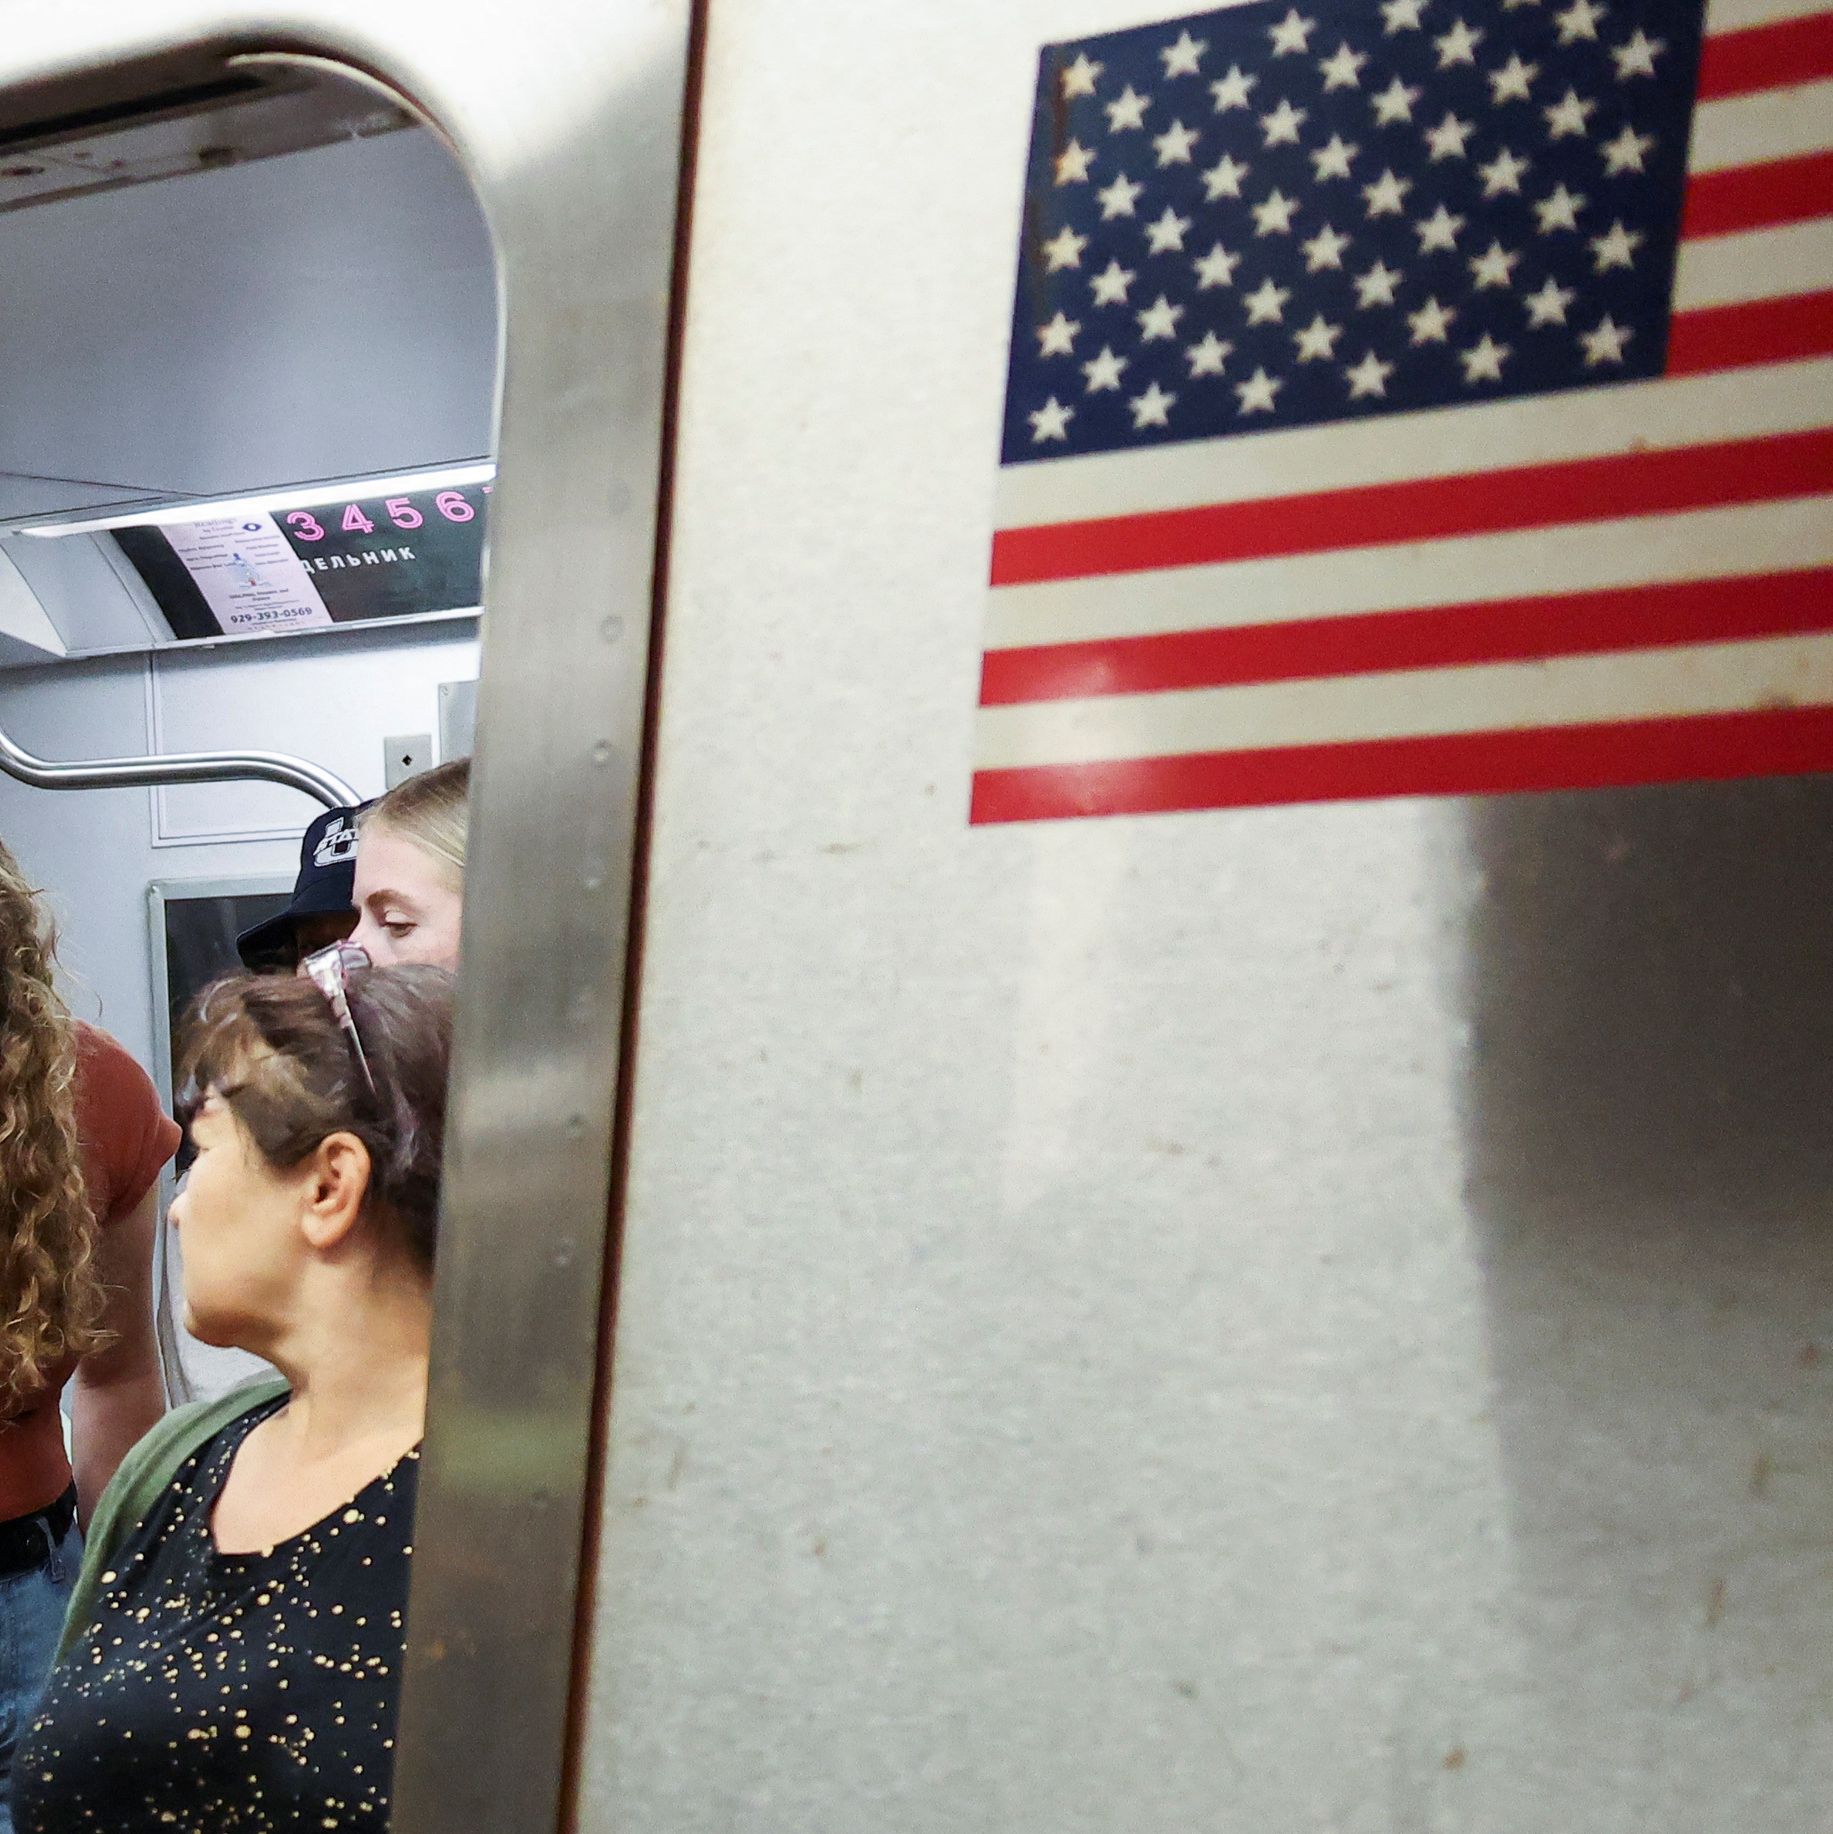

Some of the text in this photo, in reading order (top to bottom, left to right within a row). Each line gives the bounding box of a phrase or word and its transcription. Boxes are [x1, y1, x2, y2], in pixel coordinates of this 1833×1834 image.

[286, 490, 475, 541] 3 4 5 6
[302, 547, 416, 575] ДЕЛЬНИК
